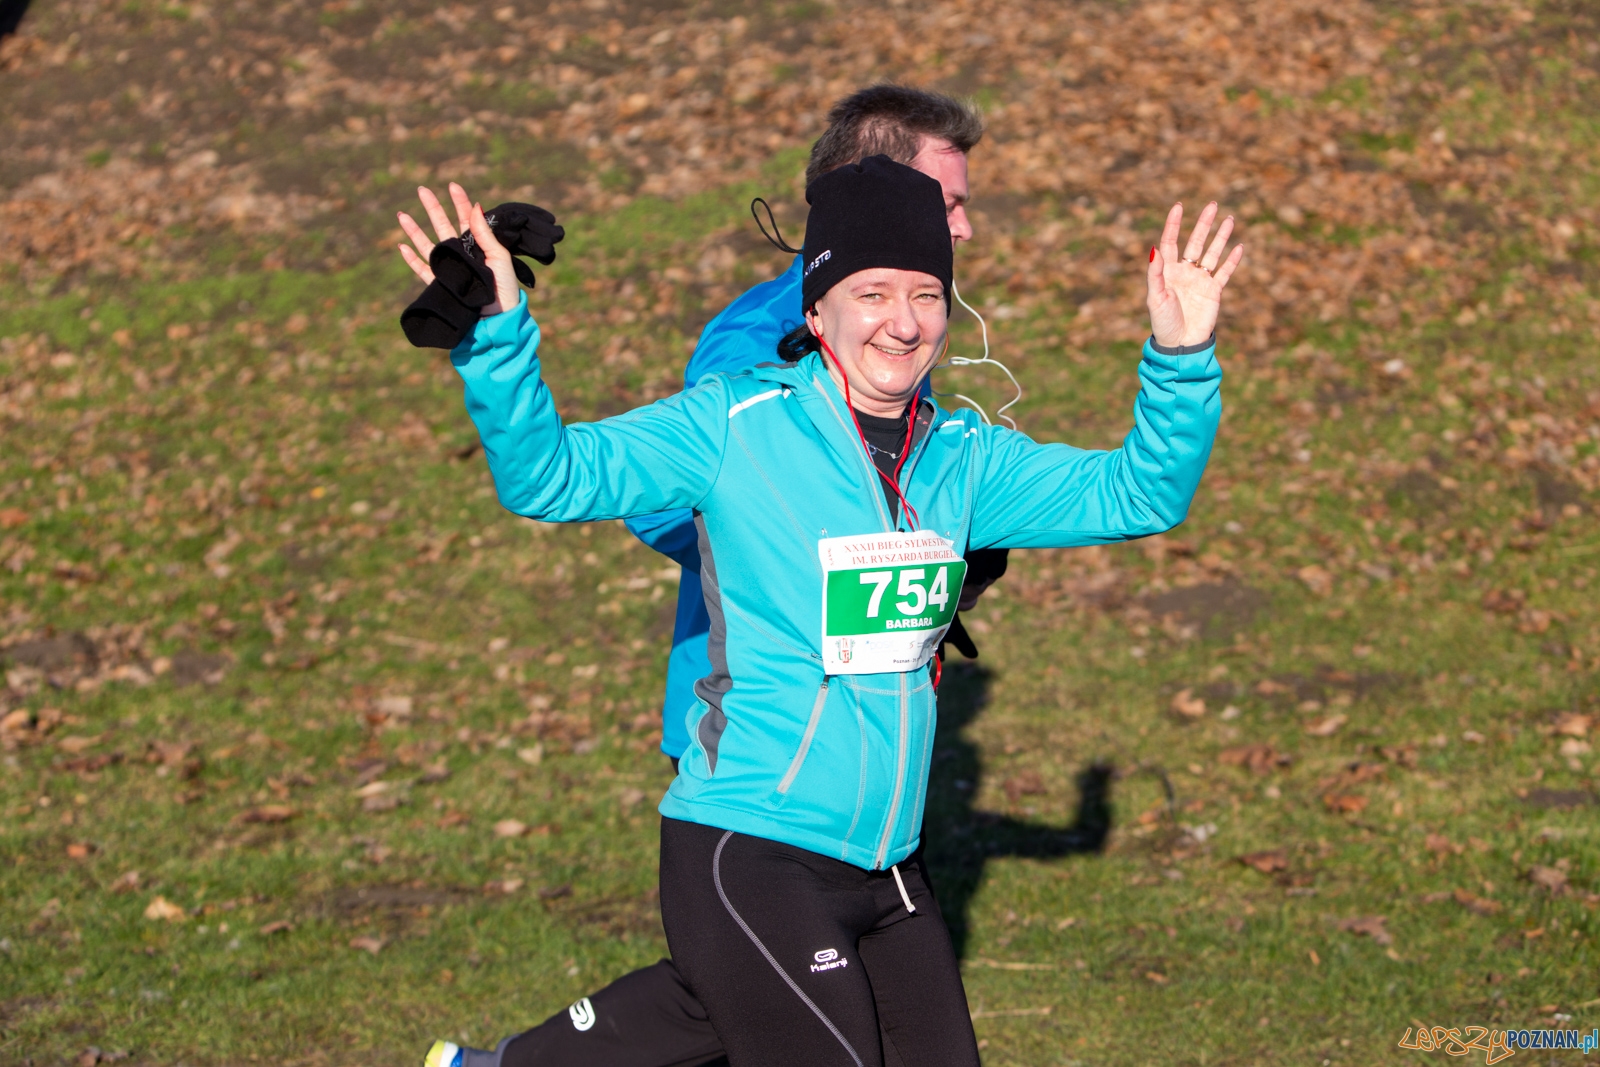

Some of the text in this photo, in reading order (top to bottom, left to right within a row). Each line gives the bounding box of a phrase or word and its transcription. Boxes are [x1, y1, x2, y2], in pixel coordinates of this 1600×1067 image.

[844, 537, 949, 554] XXXII BIEG SYLWESTR
[852, 555, 869, 566] IM.
[870, 551, 923, 564] RYSZARDA
[859, 566, 949, 619] 754
[885, 617, 933, 630] BARBARA
